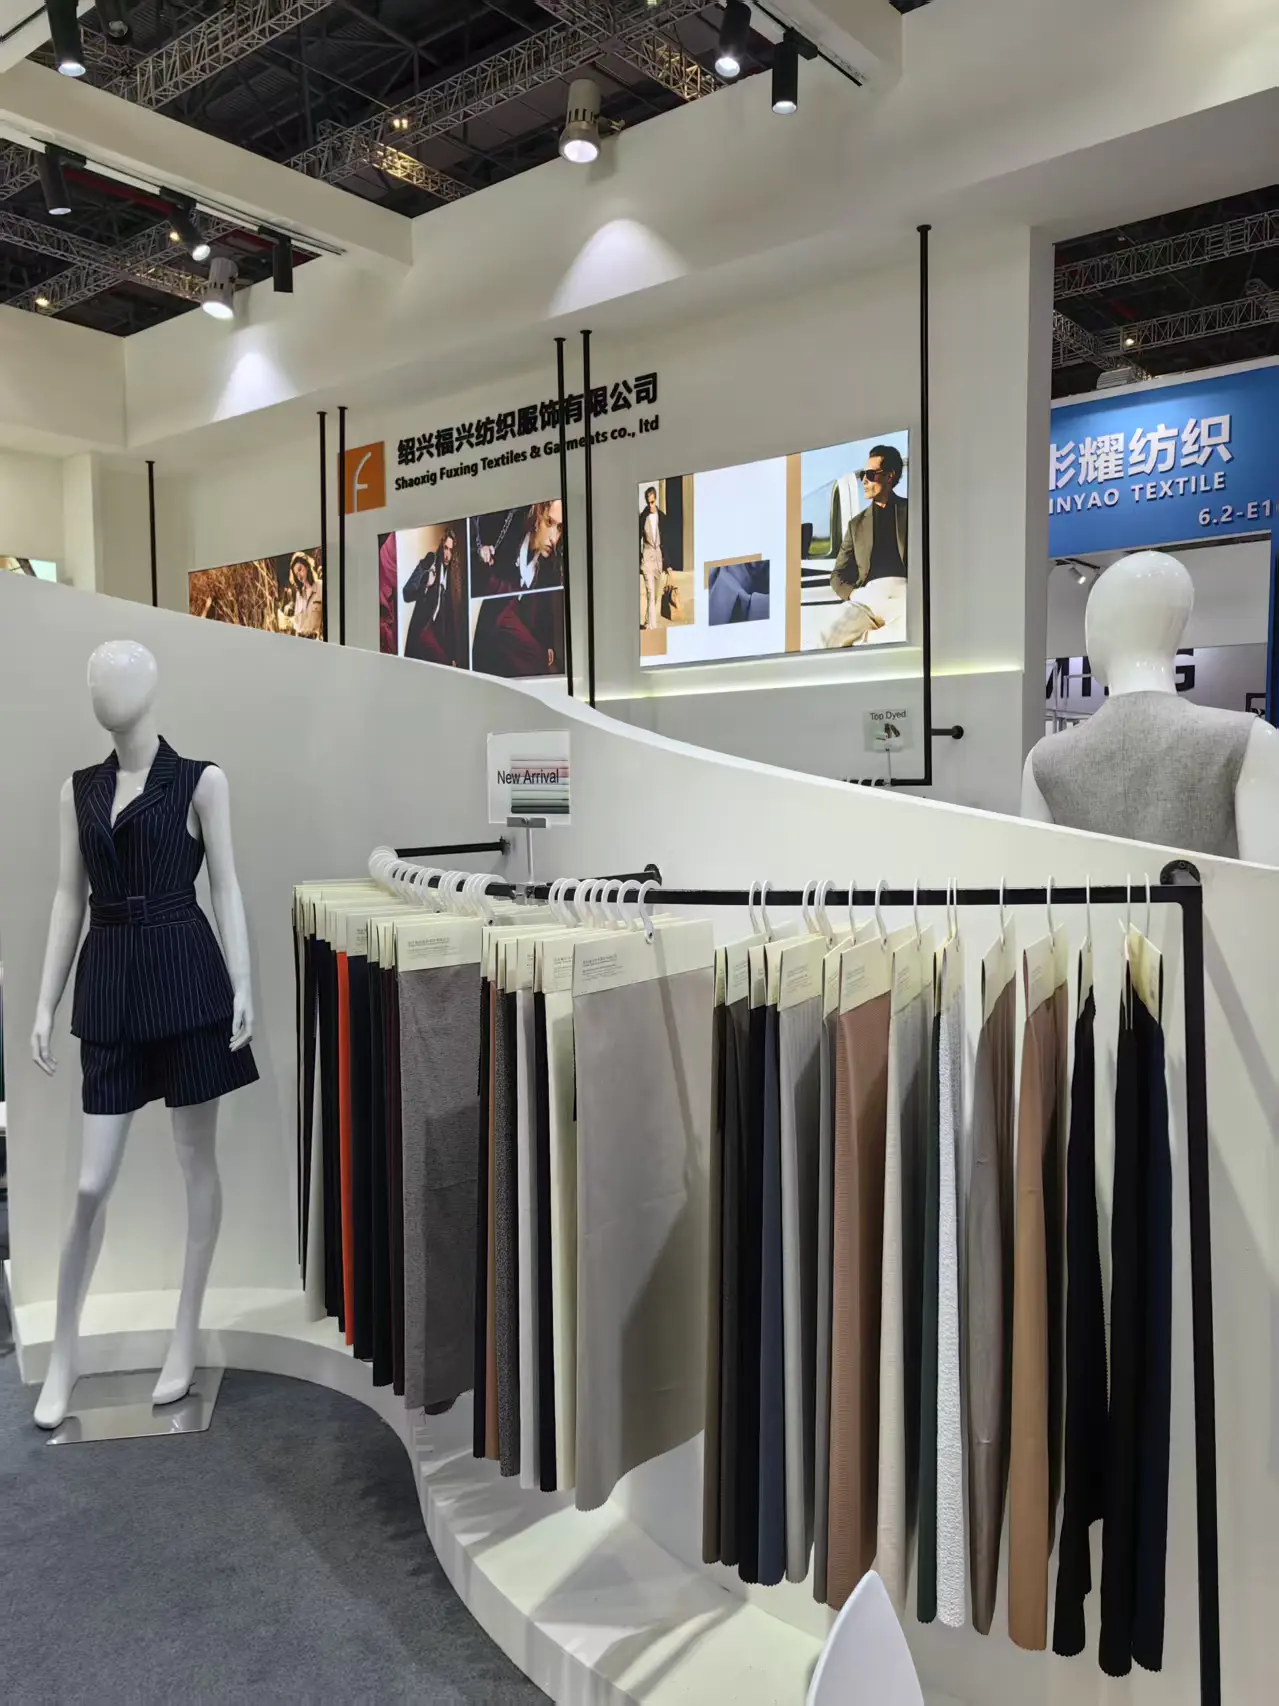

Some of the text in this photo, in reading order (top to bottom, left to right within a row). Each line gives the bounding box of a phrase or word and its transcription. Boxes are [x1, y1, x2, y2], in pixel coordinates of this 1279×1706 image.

[397, 372, 658, 466] 绍兴福兴纺织服饰有限公司
[440, 462, 478, 480] Fuxing
[480, 450, 527, 471] Textiles
[529, 445, 541, 459] &
[543, 431, 608, 456] Gamets
[610, 427, 636, 441] co.,
[1131, 472, 1226, 502] TEXTILE
[870, 711, 906, 720] Top Dyed
[497, 768, 559, 784] New Arrival
